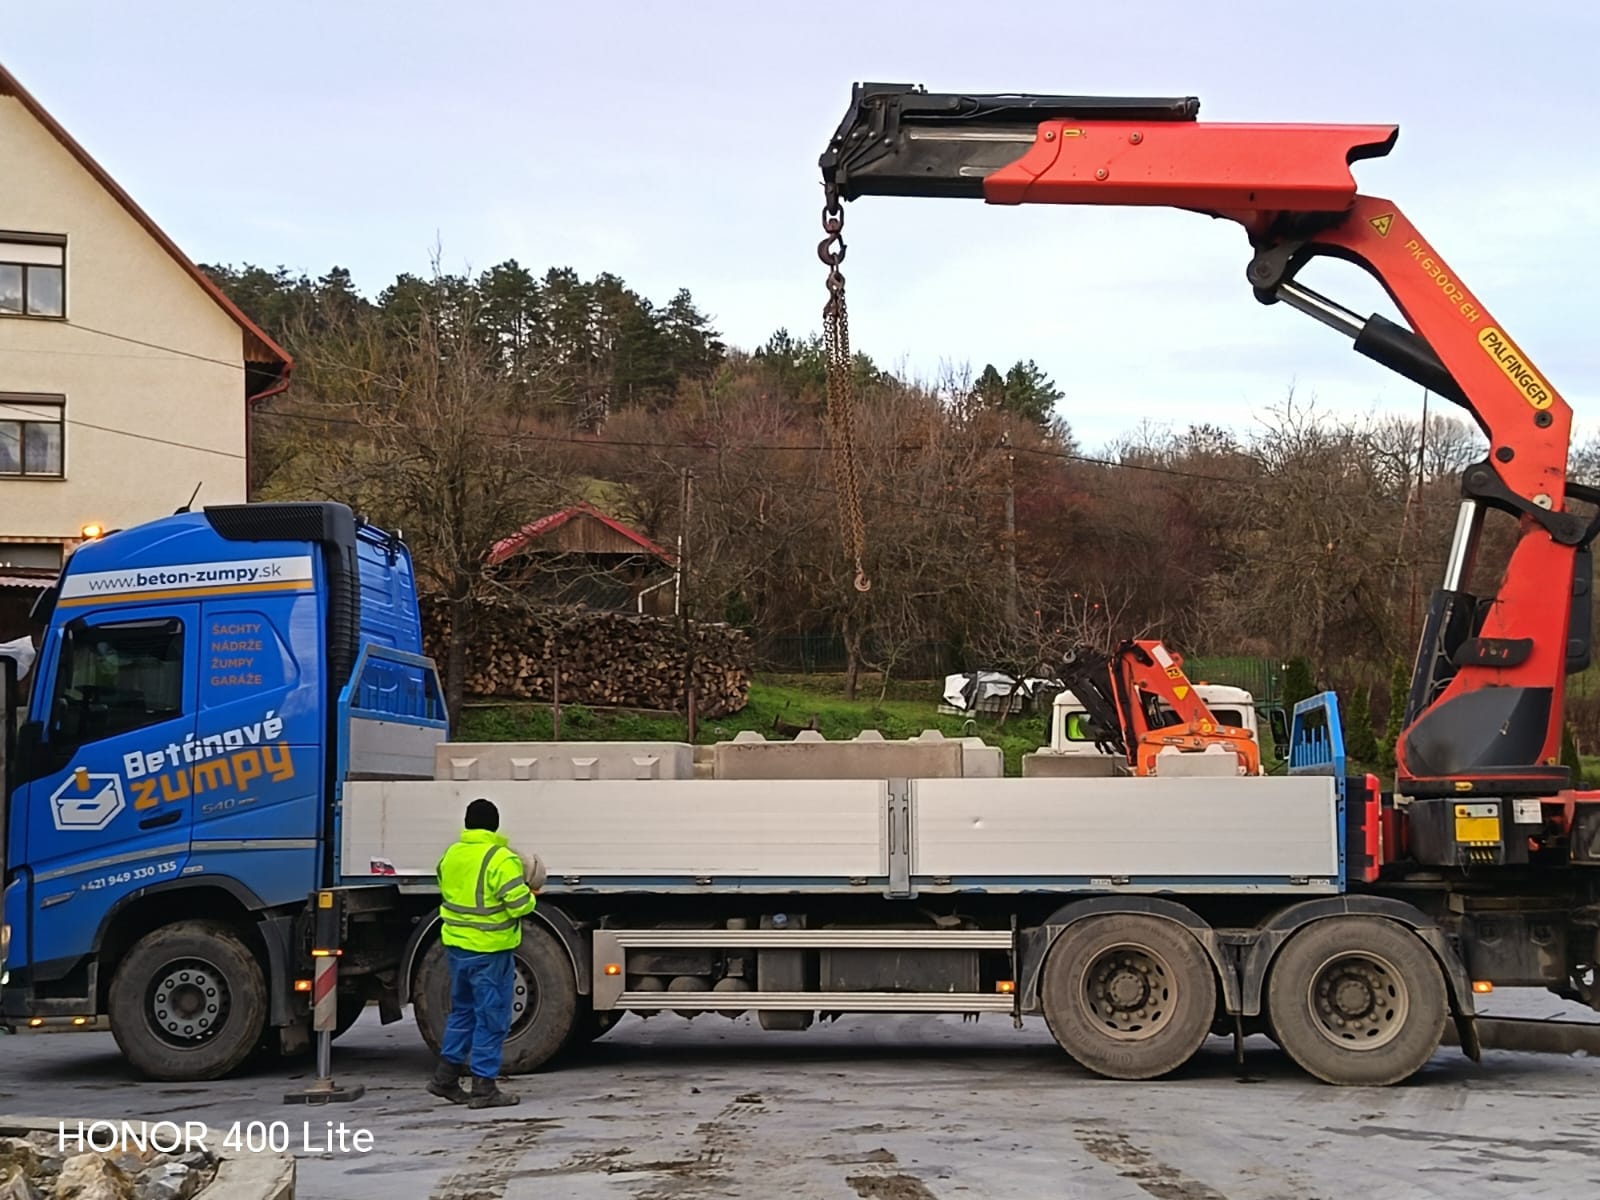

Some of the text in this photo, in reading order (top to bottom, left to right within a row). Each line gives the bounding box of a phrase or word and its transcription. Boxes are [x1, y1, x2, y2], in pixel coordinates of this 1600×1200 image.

[1404, 239, 1426, 260] PK
[1482, 331, 1548, 405] PALFINGER
[88, 562, 281, 591] www.beton-zumpy.sk
[212, 623, 261, 635] ŠACHTY
[211, 639, 263, 651] NÁDRŽE
[211, 657, 254, 669] ŽUMPY
[211, 672, 262, 686] GARÁŽE
[123, 710, 283, 779] Betónové
[130, 741, 295, 811] zumpy
[81, 877, 106, 891] +421
[108, 872, 131, 886] 949
[134, 866, 155, 879] 330
[157, 861, 177, 873] 135
